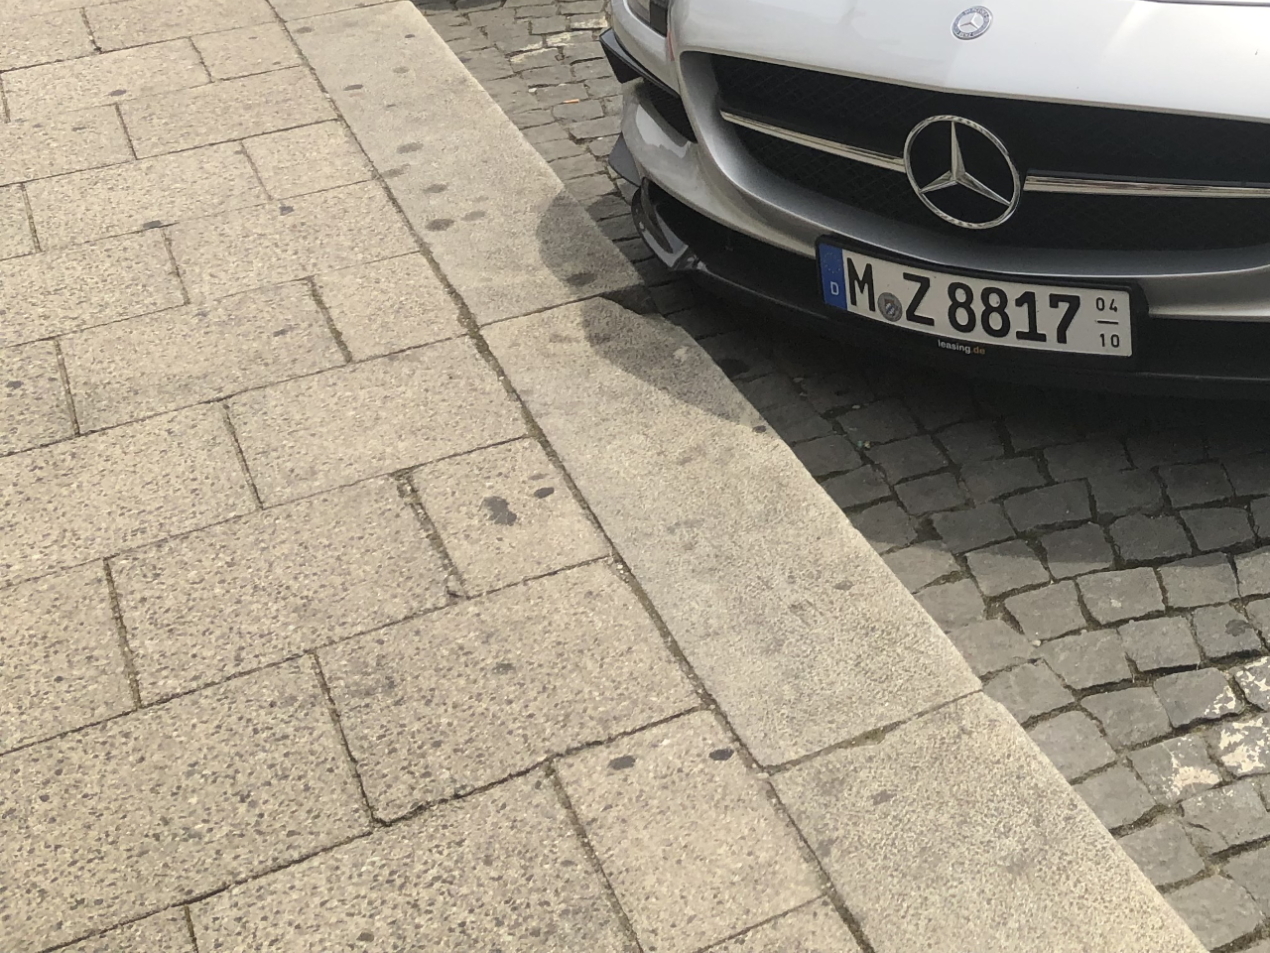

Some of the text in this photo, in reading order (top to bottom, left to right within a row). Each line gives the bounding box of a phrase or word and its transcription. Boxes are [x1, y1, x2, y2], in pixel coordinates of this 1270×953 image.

[830, 281, 840, 296] D
[847, 257, 1081, 344] M Z 8817
[1095, 296, 1119, 313] 04
[1099, 332, 1121, 348] 10
